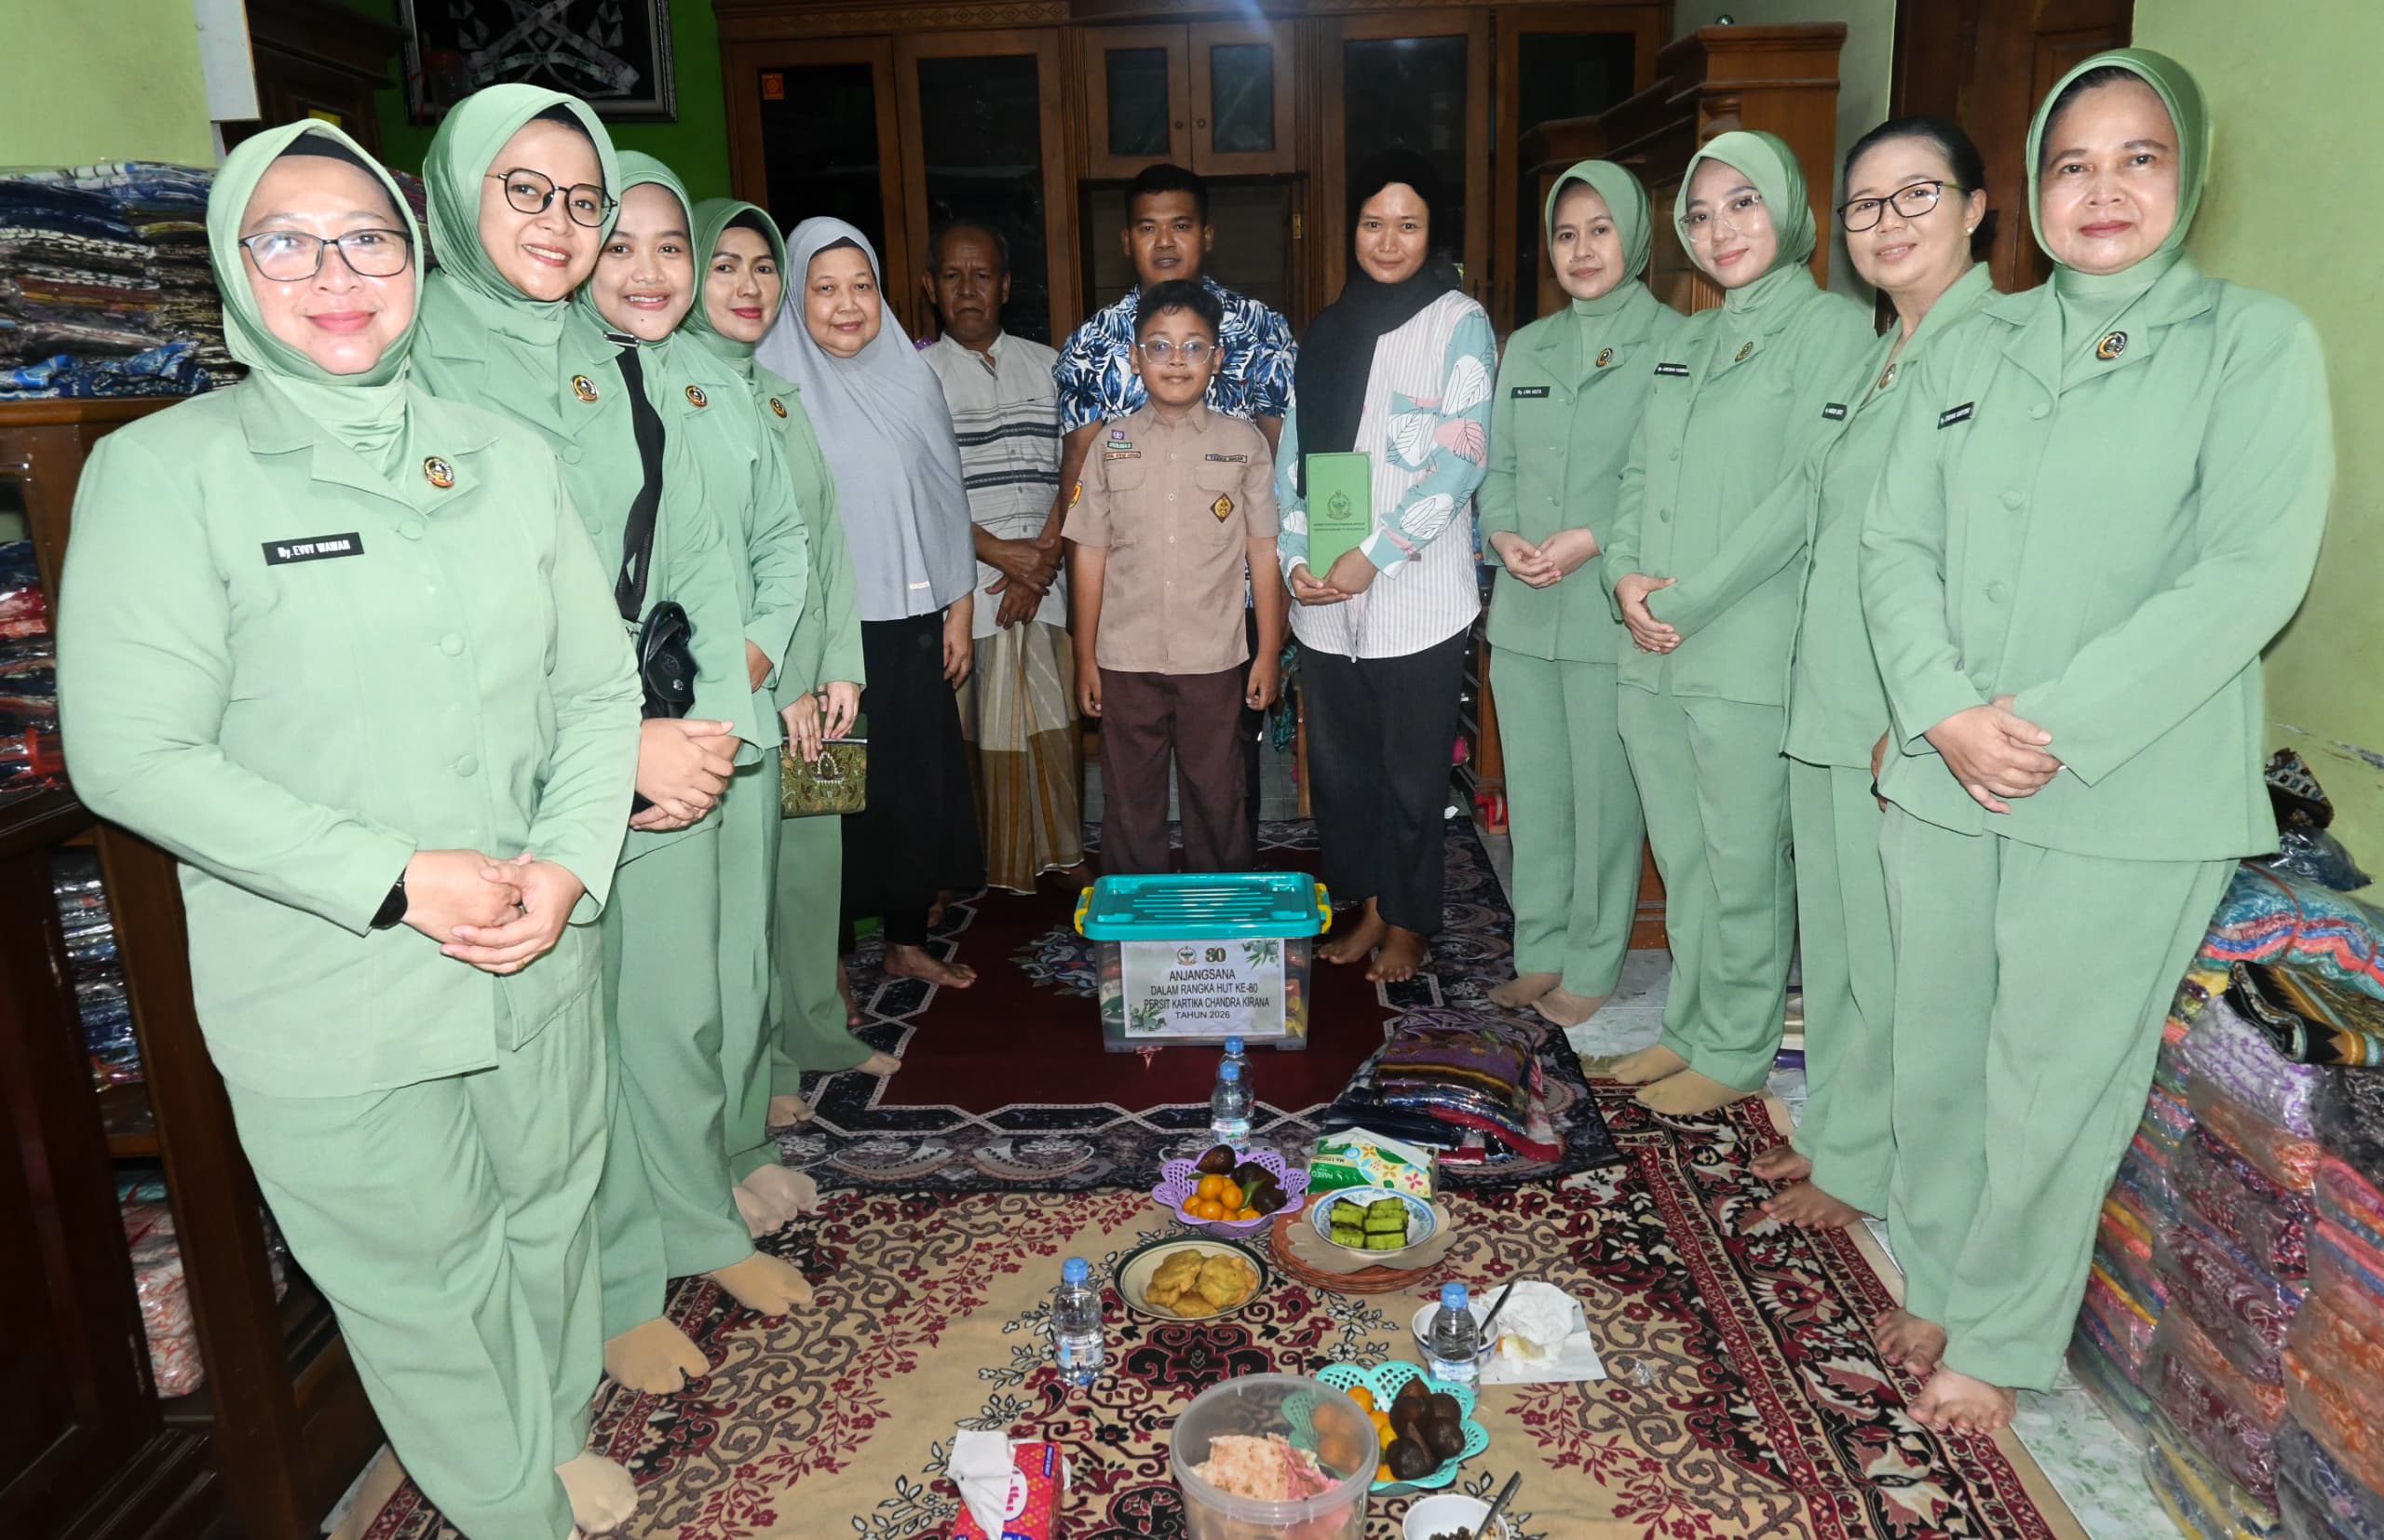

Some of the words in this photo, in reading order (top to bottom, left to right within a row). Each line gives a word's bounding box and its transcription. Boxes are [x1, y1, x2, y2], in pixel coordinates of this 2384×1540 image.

[1205, 947, 1226, 963] 80
[1169, 968, 1236, 981] ANJANGSANA
[1150, 984, 1179, 996] DALAM
[1181, 983, 1215, 995] RANGKA
[1216, 983, 1233, 993] HUT
[1235, 982, 1258, 993] KE-80
[1144, 998, 1171, 1010] PERSIT
[1172, 997, 1204, 1008] KARTIKA
[1204, 996, 1241, 1008] CHANDRA
[1241, 995, 1270, 1007] KIRANA
[1174, 1011, 1208, 1020] TAHUN
[1209, 1010, 1230, 1019] 2026
